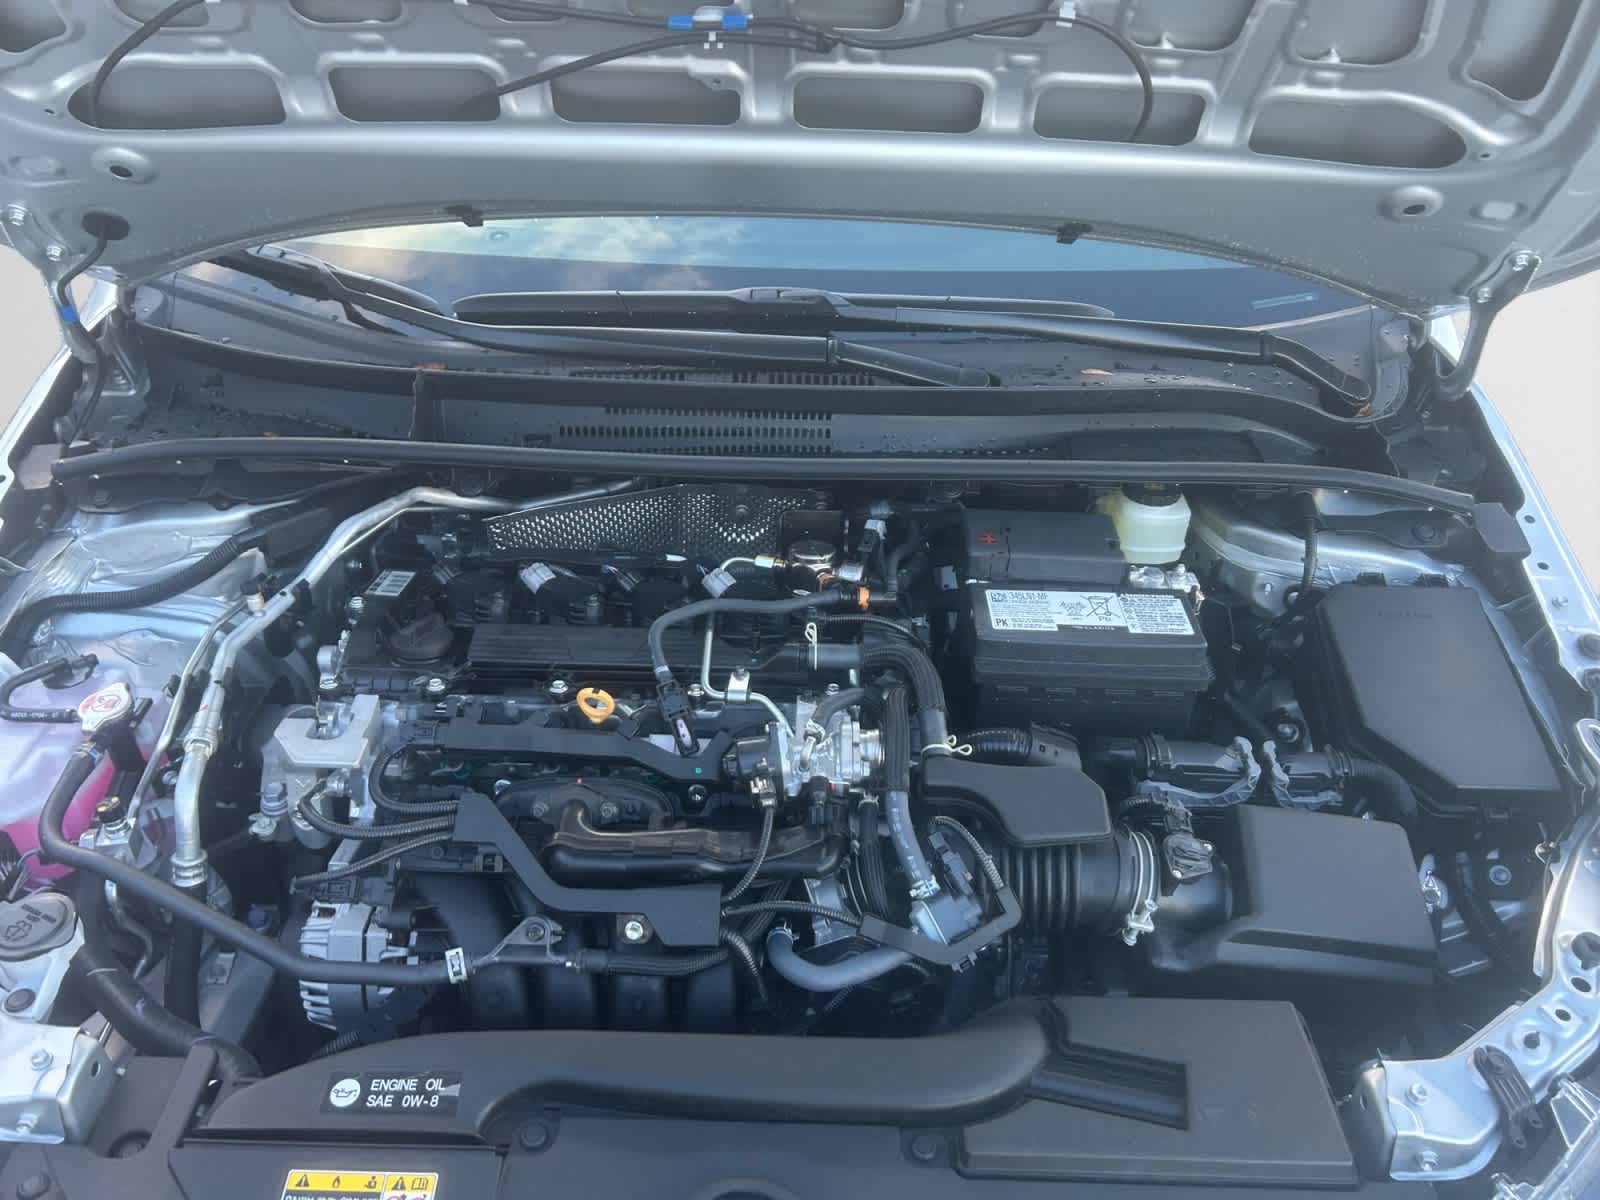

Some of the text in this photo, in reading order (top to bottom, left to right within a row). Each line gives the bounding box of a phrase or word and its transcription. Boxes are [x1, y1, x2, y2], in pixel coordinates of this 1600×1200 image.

[995, 618, 1008, 627] PK
[370, 1079, 446, 1091] ENGINE OIL
[366, 1095, 439, 1107] SAE 0W-8
